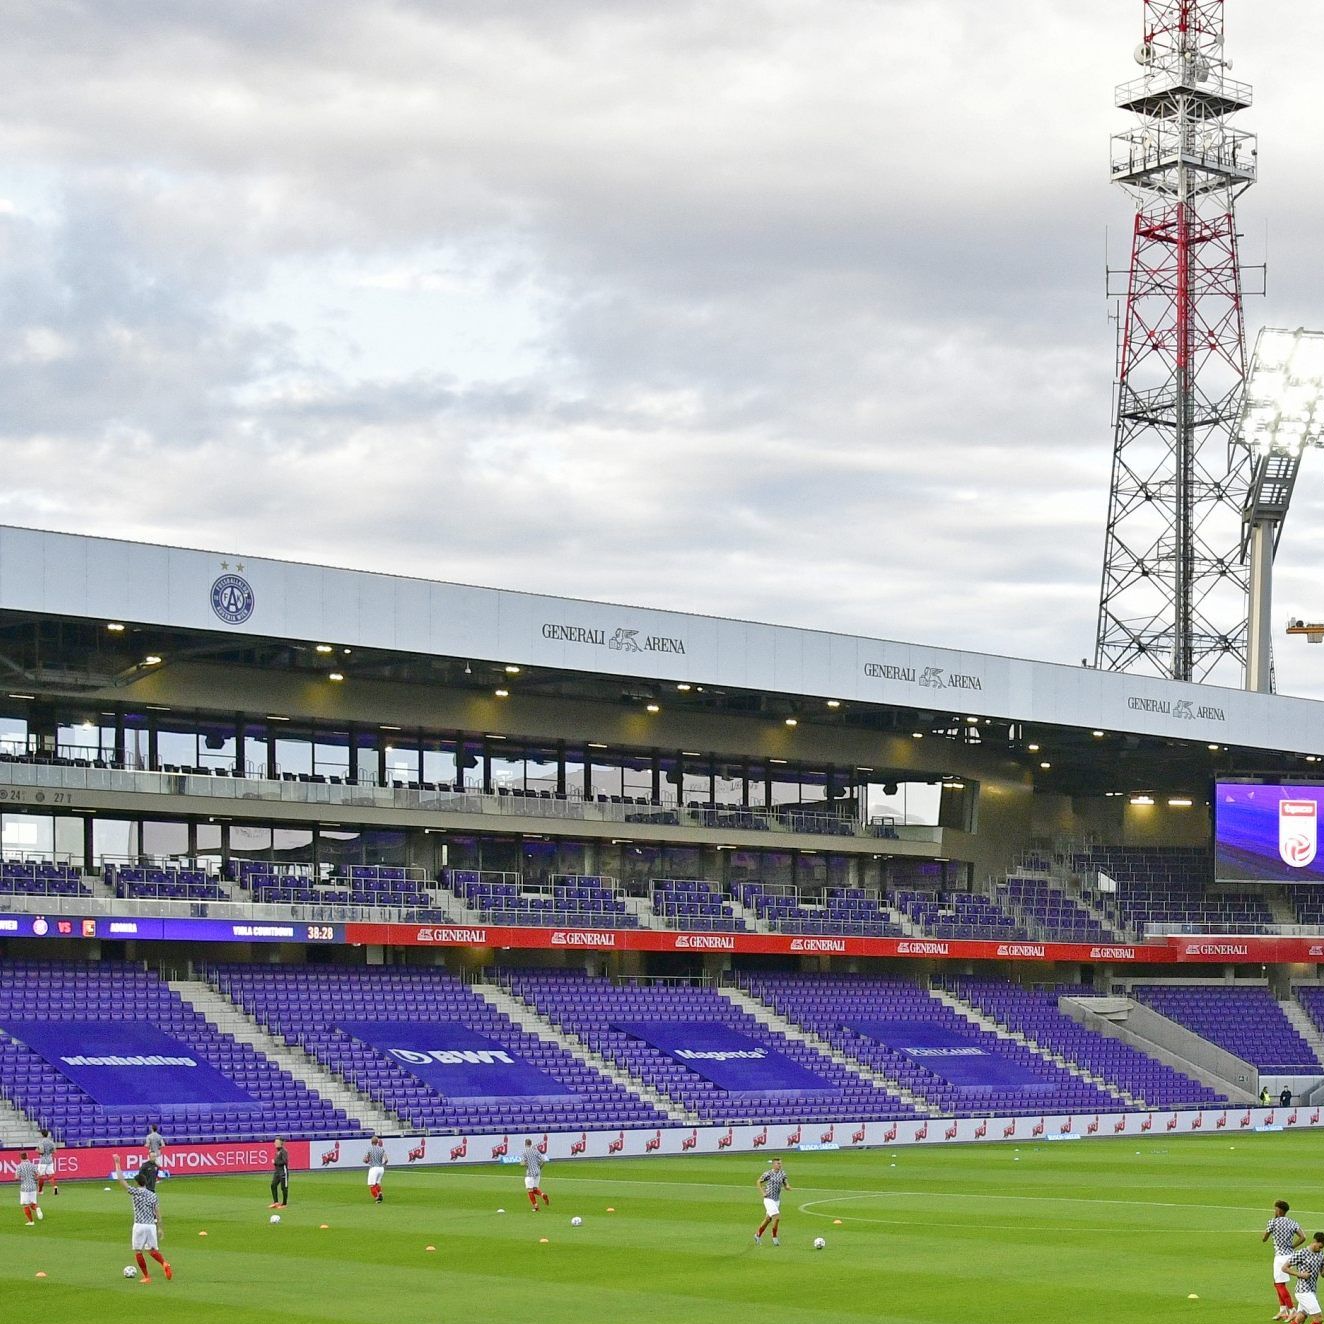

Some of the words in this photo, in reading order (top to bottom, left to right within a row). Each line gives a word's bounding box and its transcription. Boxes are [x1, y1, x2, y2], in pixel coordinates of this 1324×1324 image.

[541, 623, 605, 645] GENERALI
[644, 634, 685, 655] ARENA
[864, 662, 916, 683] GENERALI
[948, 672, 982, 691] ARENA
[1127, 696, 1171, 715] GENERALI
[1196, 705, 1225, 721] ARENA
[307, 926, 334, 940] 38:28
[433, 929, 486, 943] GENERALI
[566, 933, 615, 946] GENERALI
[689, 936, 734, 949] GENERALI
[803, 939, 845, 952] GENERALI
[909, 942, 948, 954] GENERALI
[1008, 945, 1045, 957] GENERALI
[1100, 947, 1135, 959] GENERALI
[1200, 944, 1247, 956] GENERALI
[432, 1050, 514, 1064] BWT
